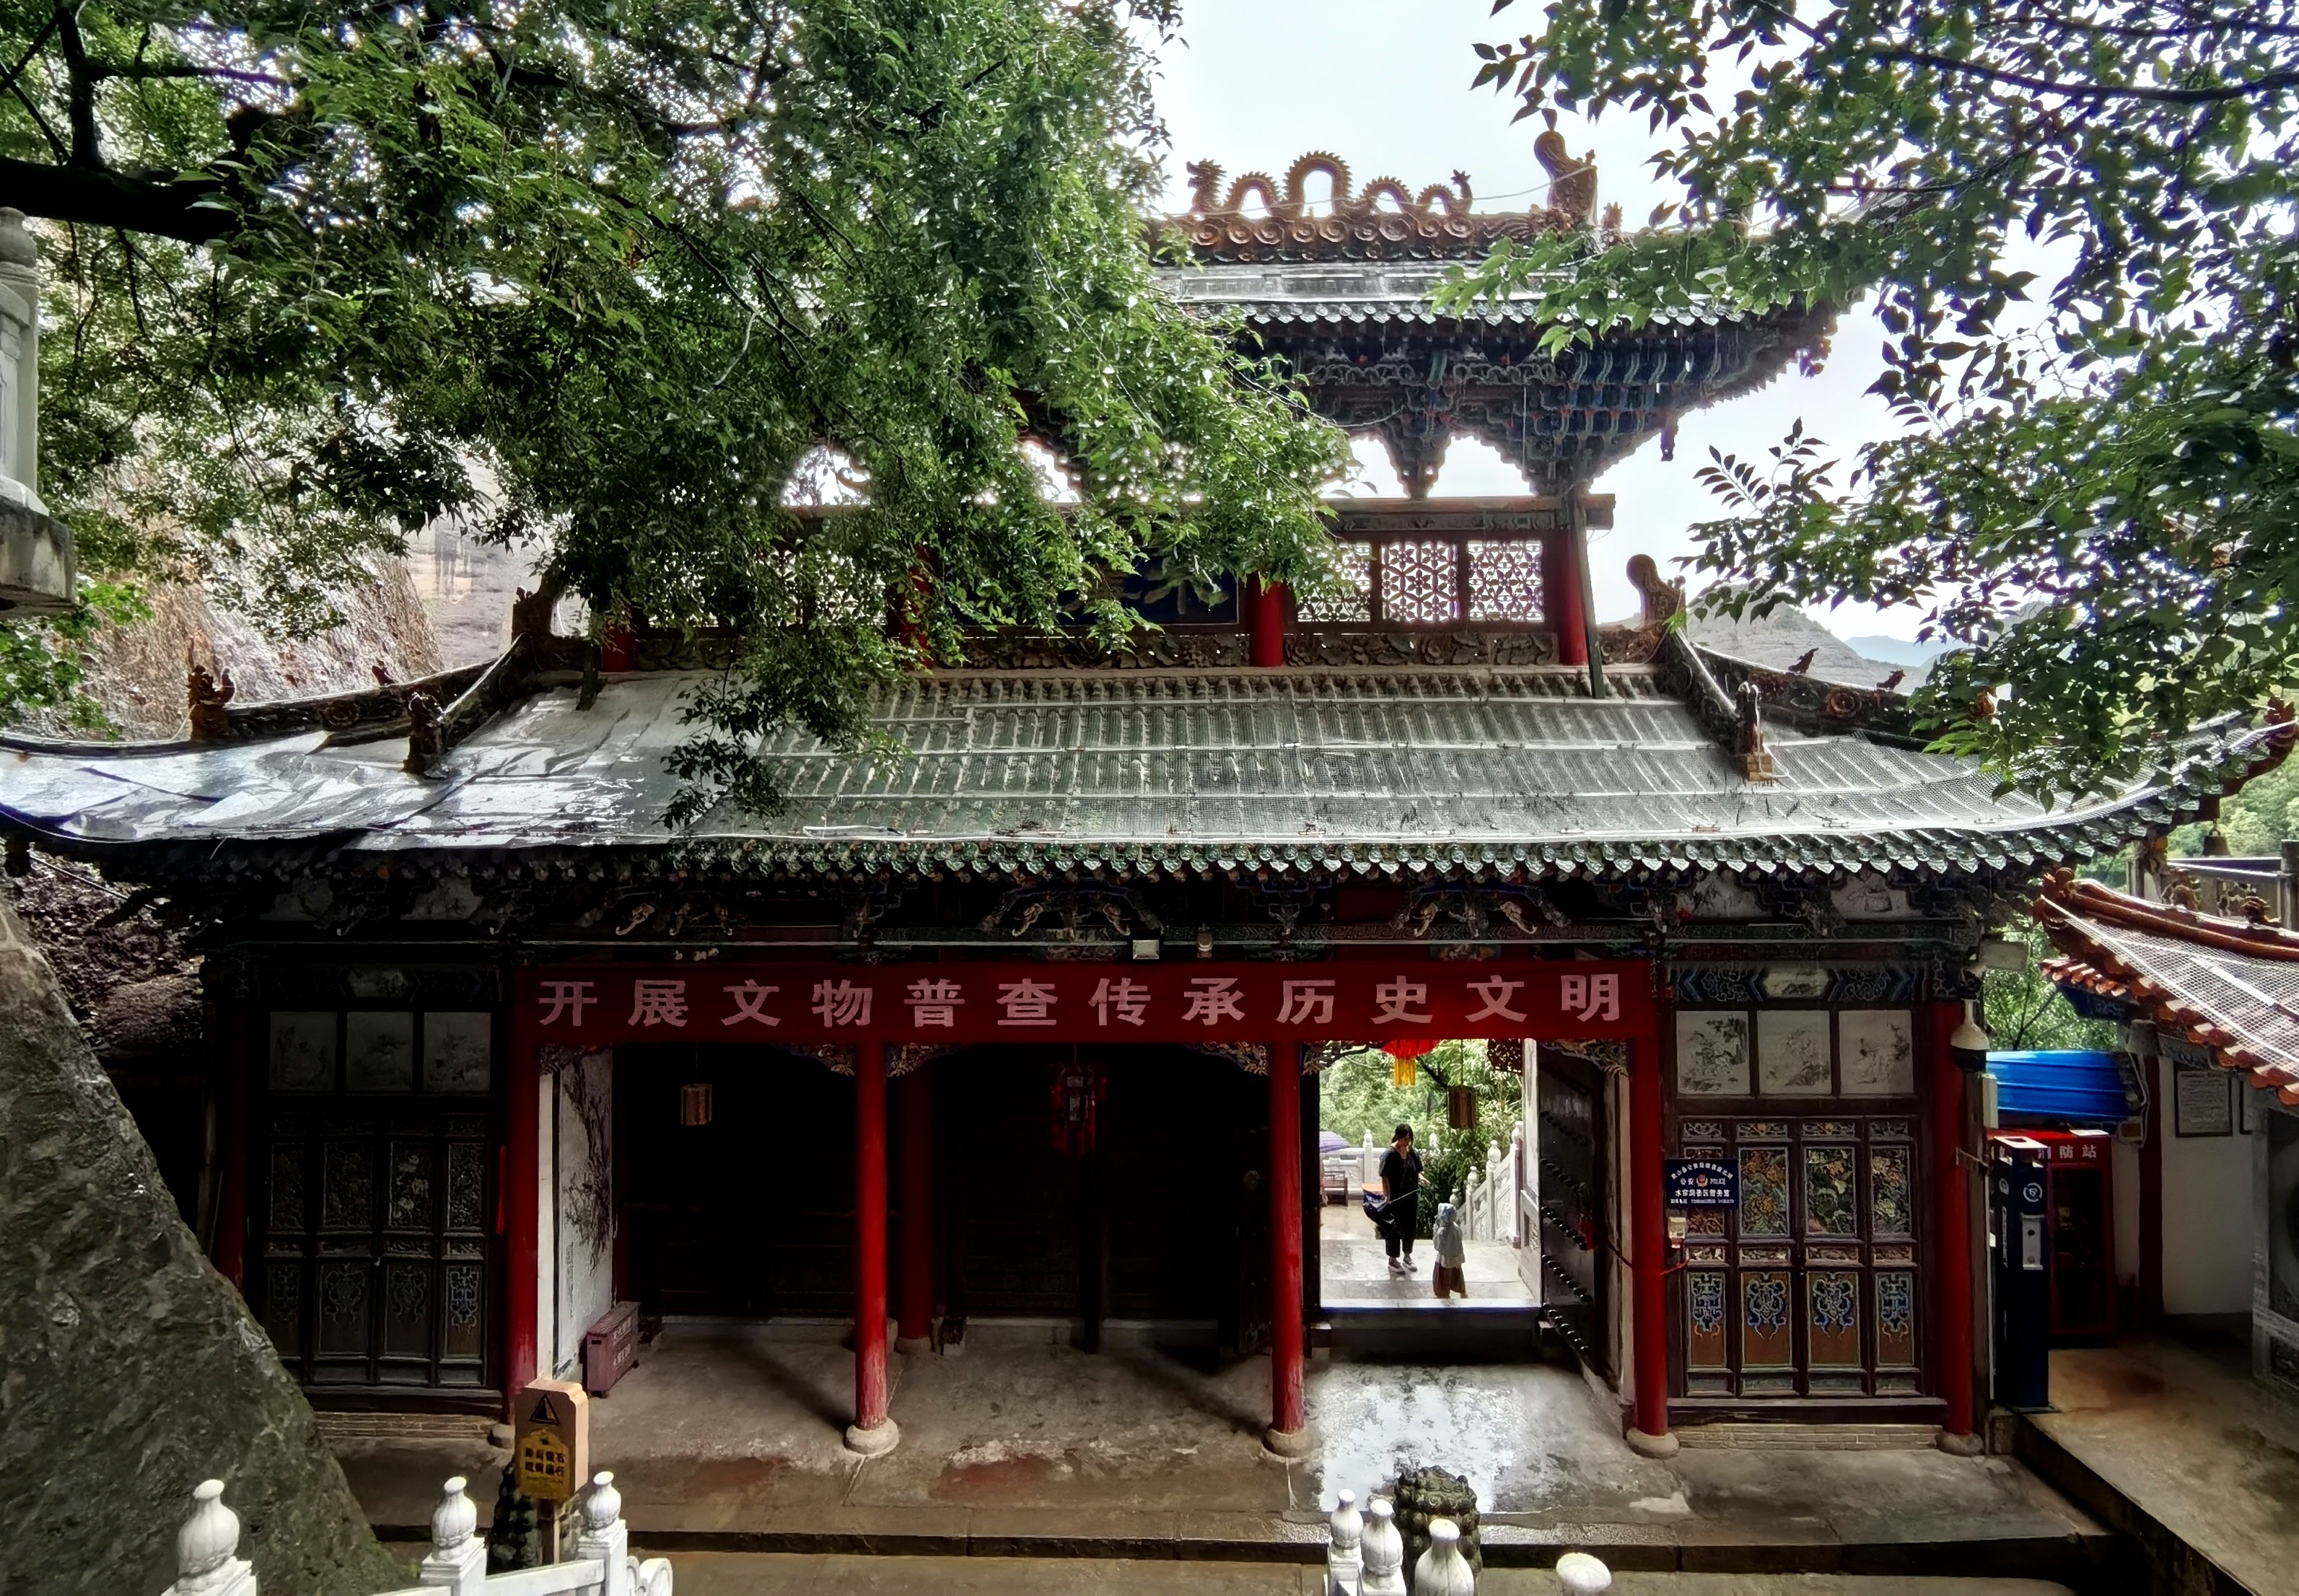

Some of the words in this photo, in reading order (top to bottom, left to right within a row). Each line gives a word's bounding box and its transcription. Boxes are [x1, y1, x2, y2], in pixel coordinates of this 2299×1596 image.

[538, 973, 1621, 1027] 开展文物普查传承历史文明
